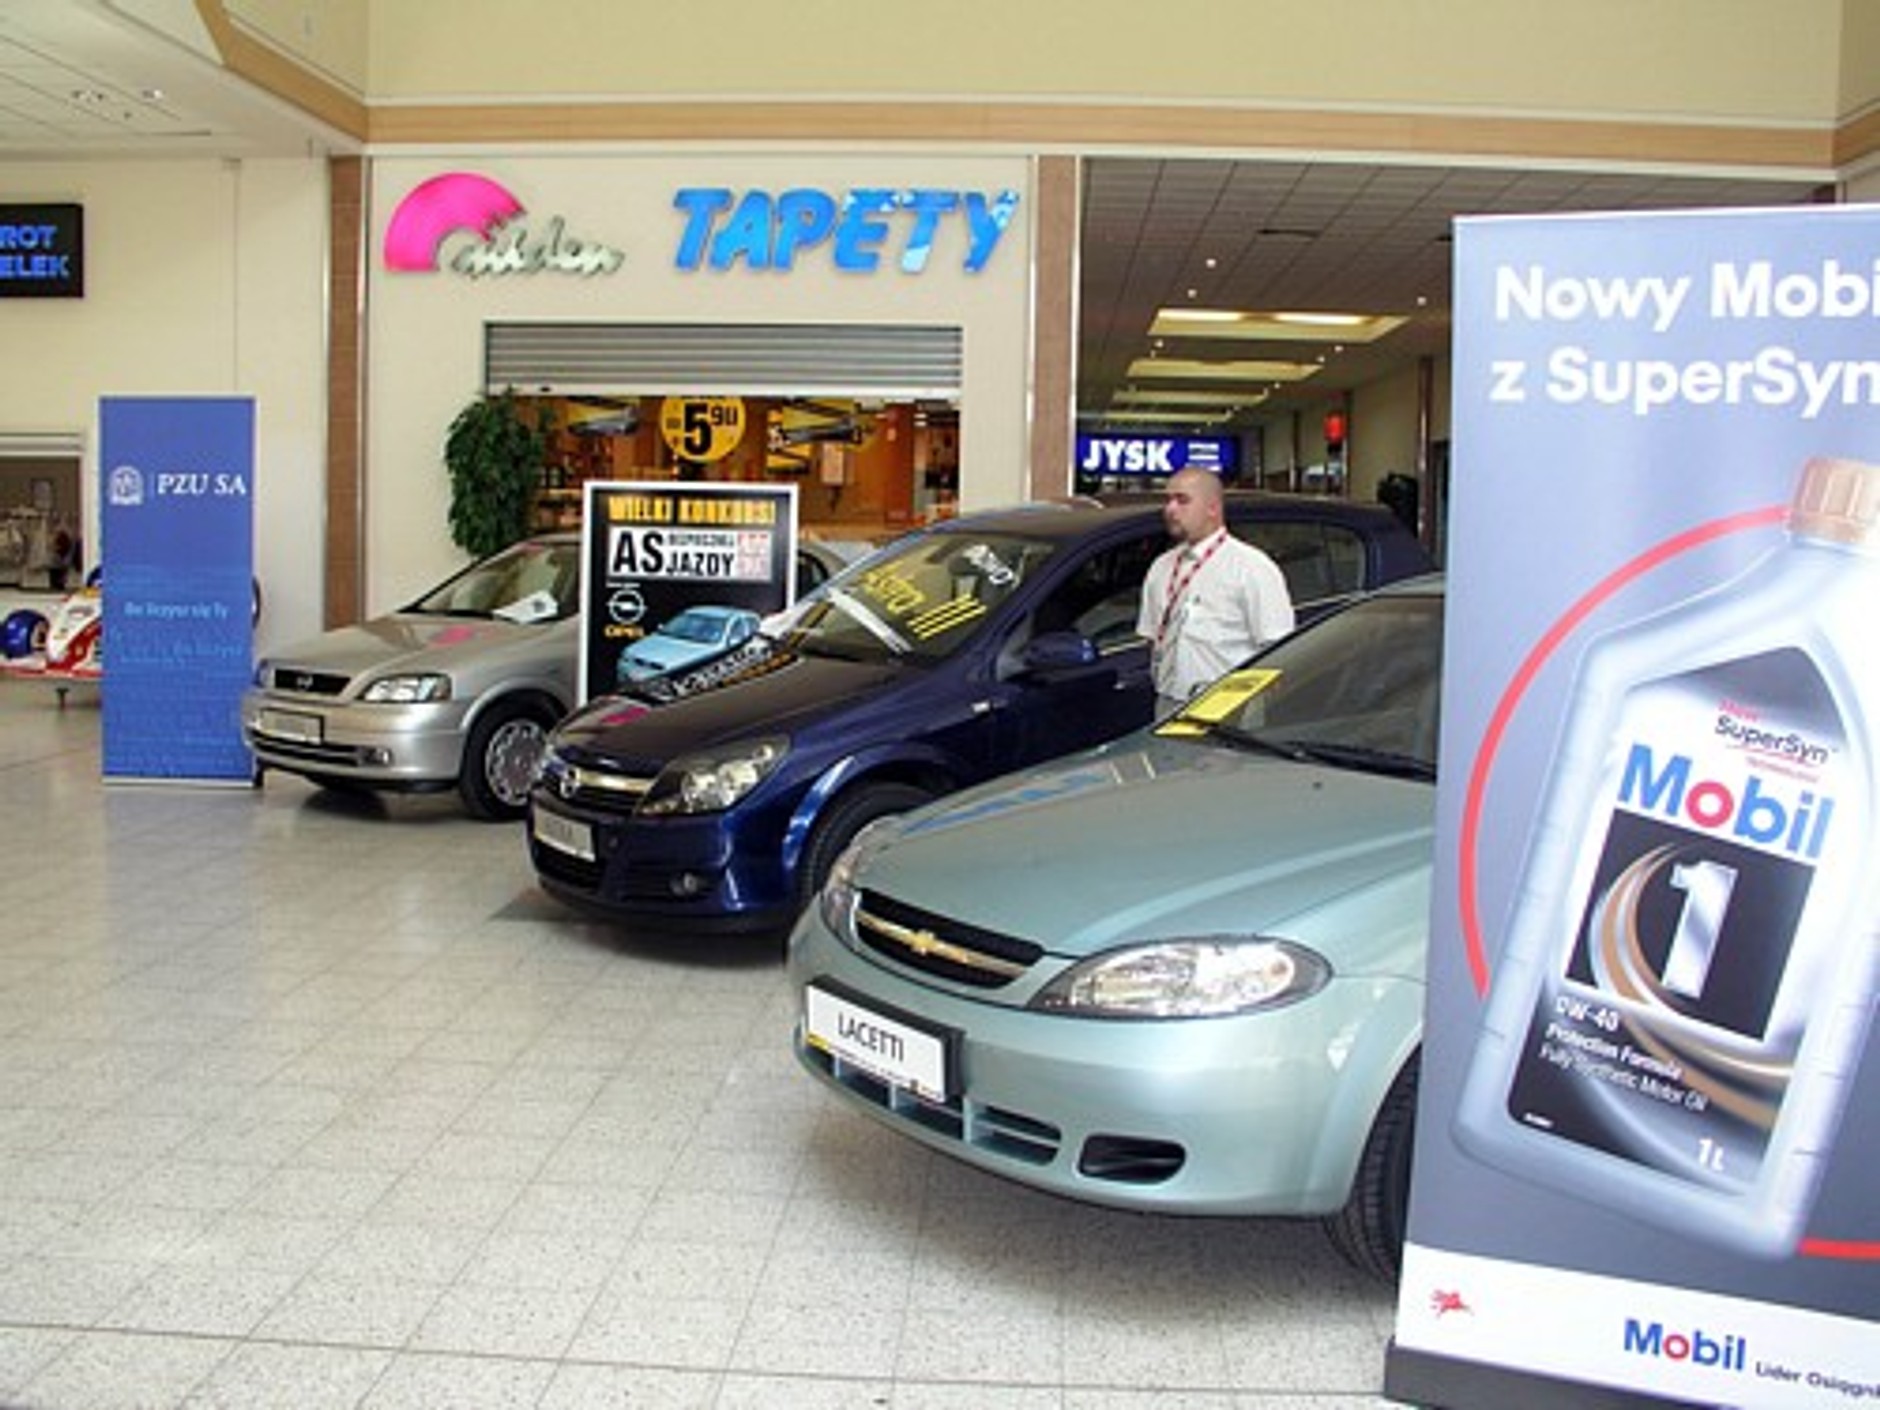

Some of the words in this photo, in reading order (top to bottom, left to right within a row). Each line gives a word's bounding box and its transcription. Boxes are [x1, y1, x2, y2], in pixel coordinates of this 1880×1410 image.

[672, 187, 1019, 274] TAPETY
[1494, 264, 1692, 332] Nowy
[1490, 358, 1526, 402] z
[1545, 345, 1880, 420] SuperSyn
[1082, 439, 1174, 473] JYSK
[156, 472, 208, 495] PZU
[214, 472, 247, 495] SA
[612, 529, 665, 574] AS
[665, 551, 736, 577] JAZDY
[1714, 714, 1829, 764] SuperSyn
[1617, 742, 1836, 859] Mobil
[1664, 860, 1739, 998] 1
[838, 1012, 904, 1062] LACETTI
[1622, 1317, 1746, 1373] Mobil
